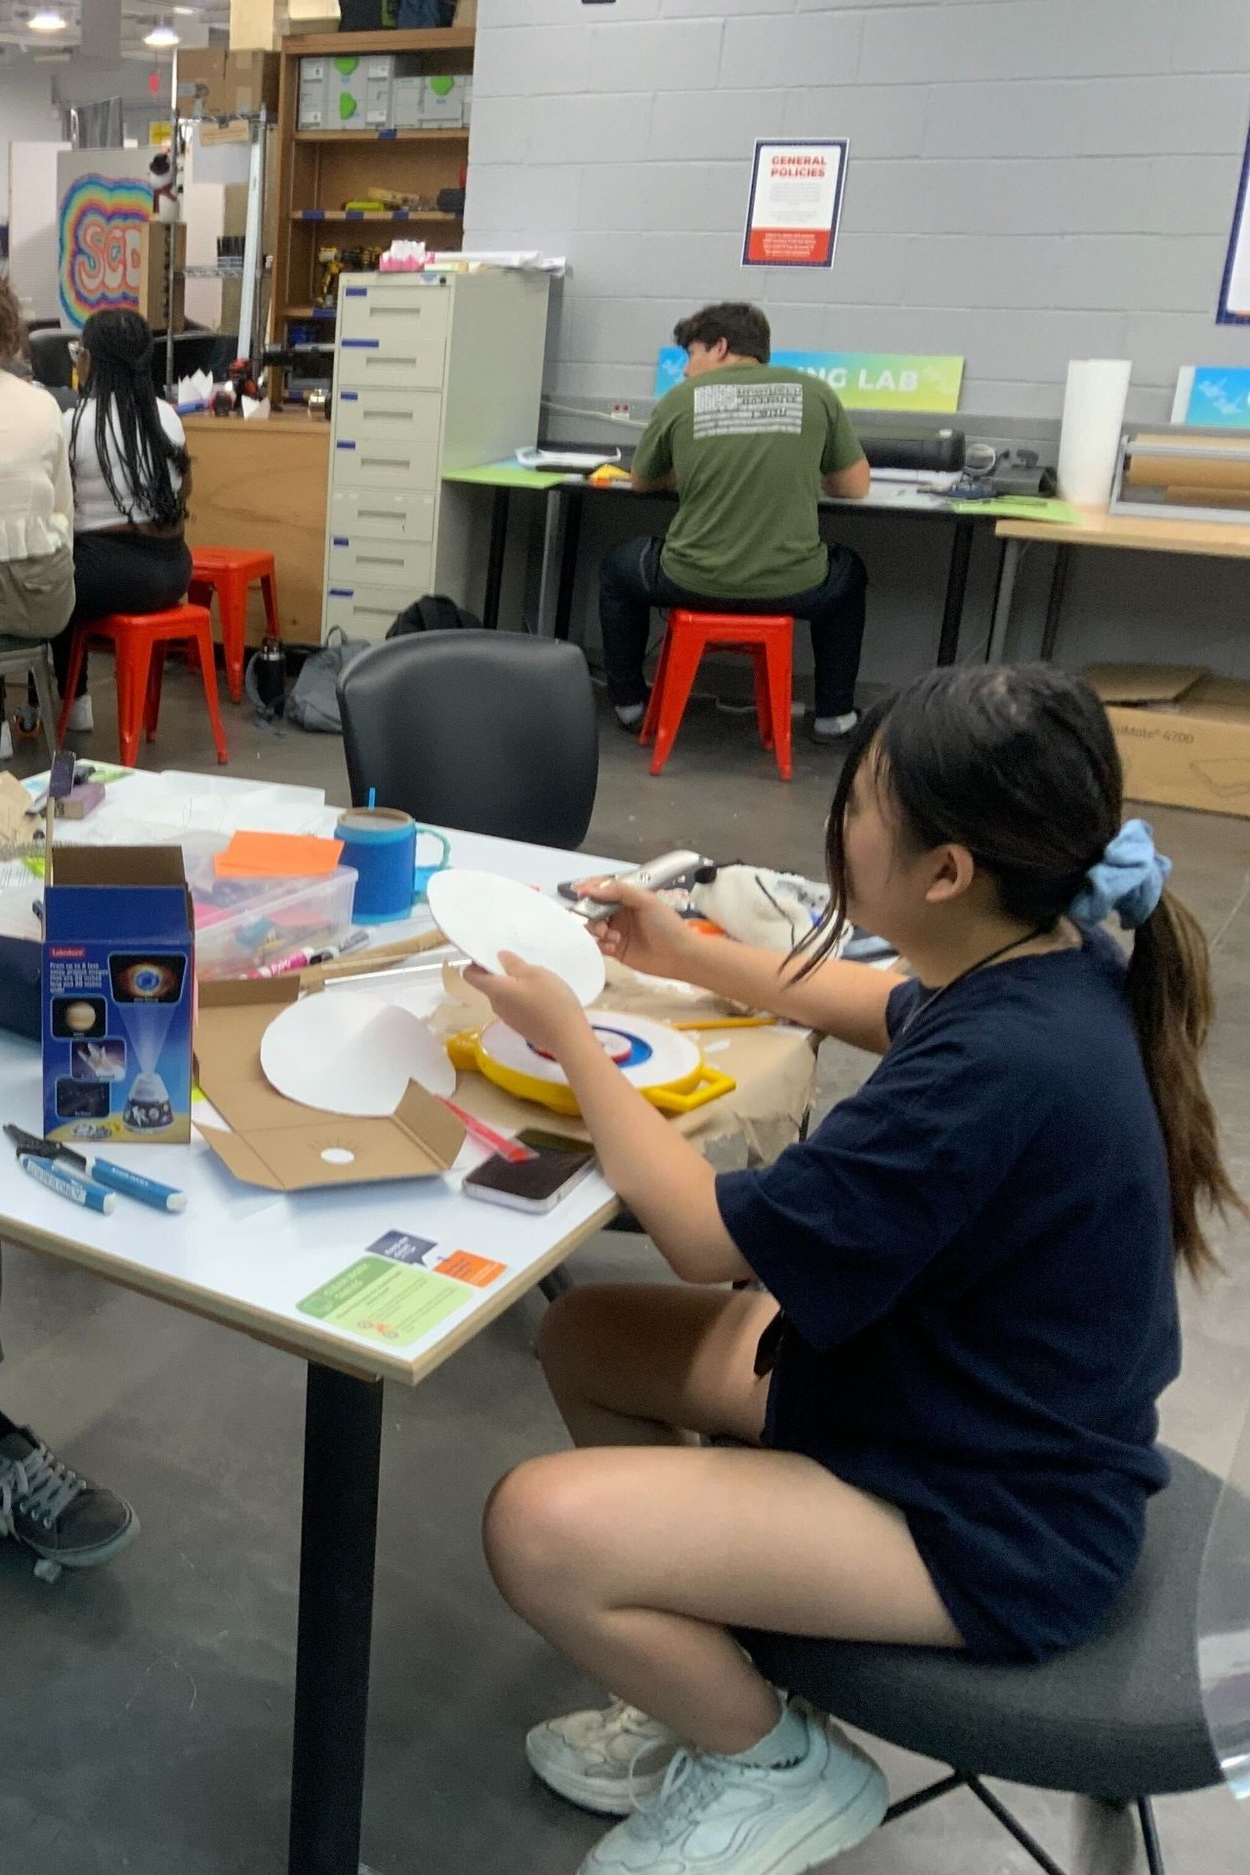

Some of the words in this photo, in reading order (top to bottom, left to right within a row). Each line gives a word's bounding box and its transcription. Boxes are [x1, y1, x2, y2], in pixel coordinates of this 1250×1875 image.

[771, 156, 827, 166] GENERAL
[771, 167, 826, 177] POLICIES
[858, 368, 918, 391] LAB
